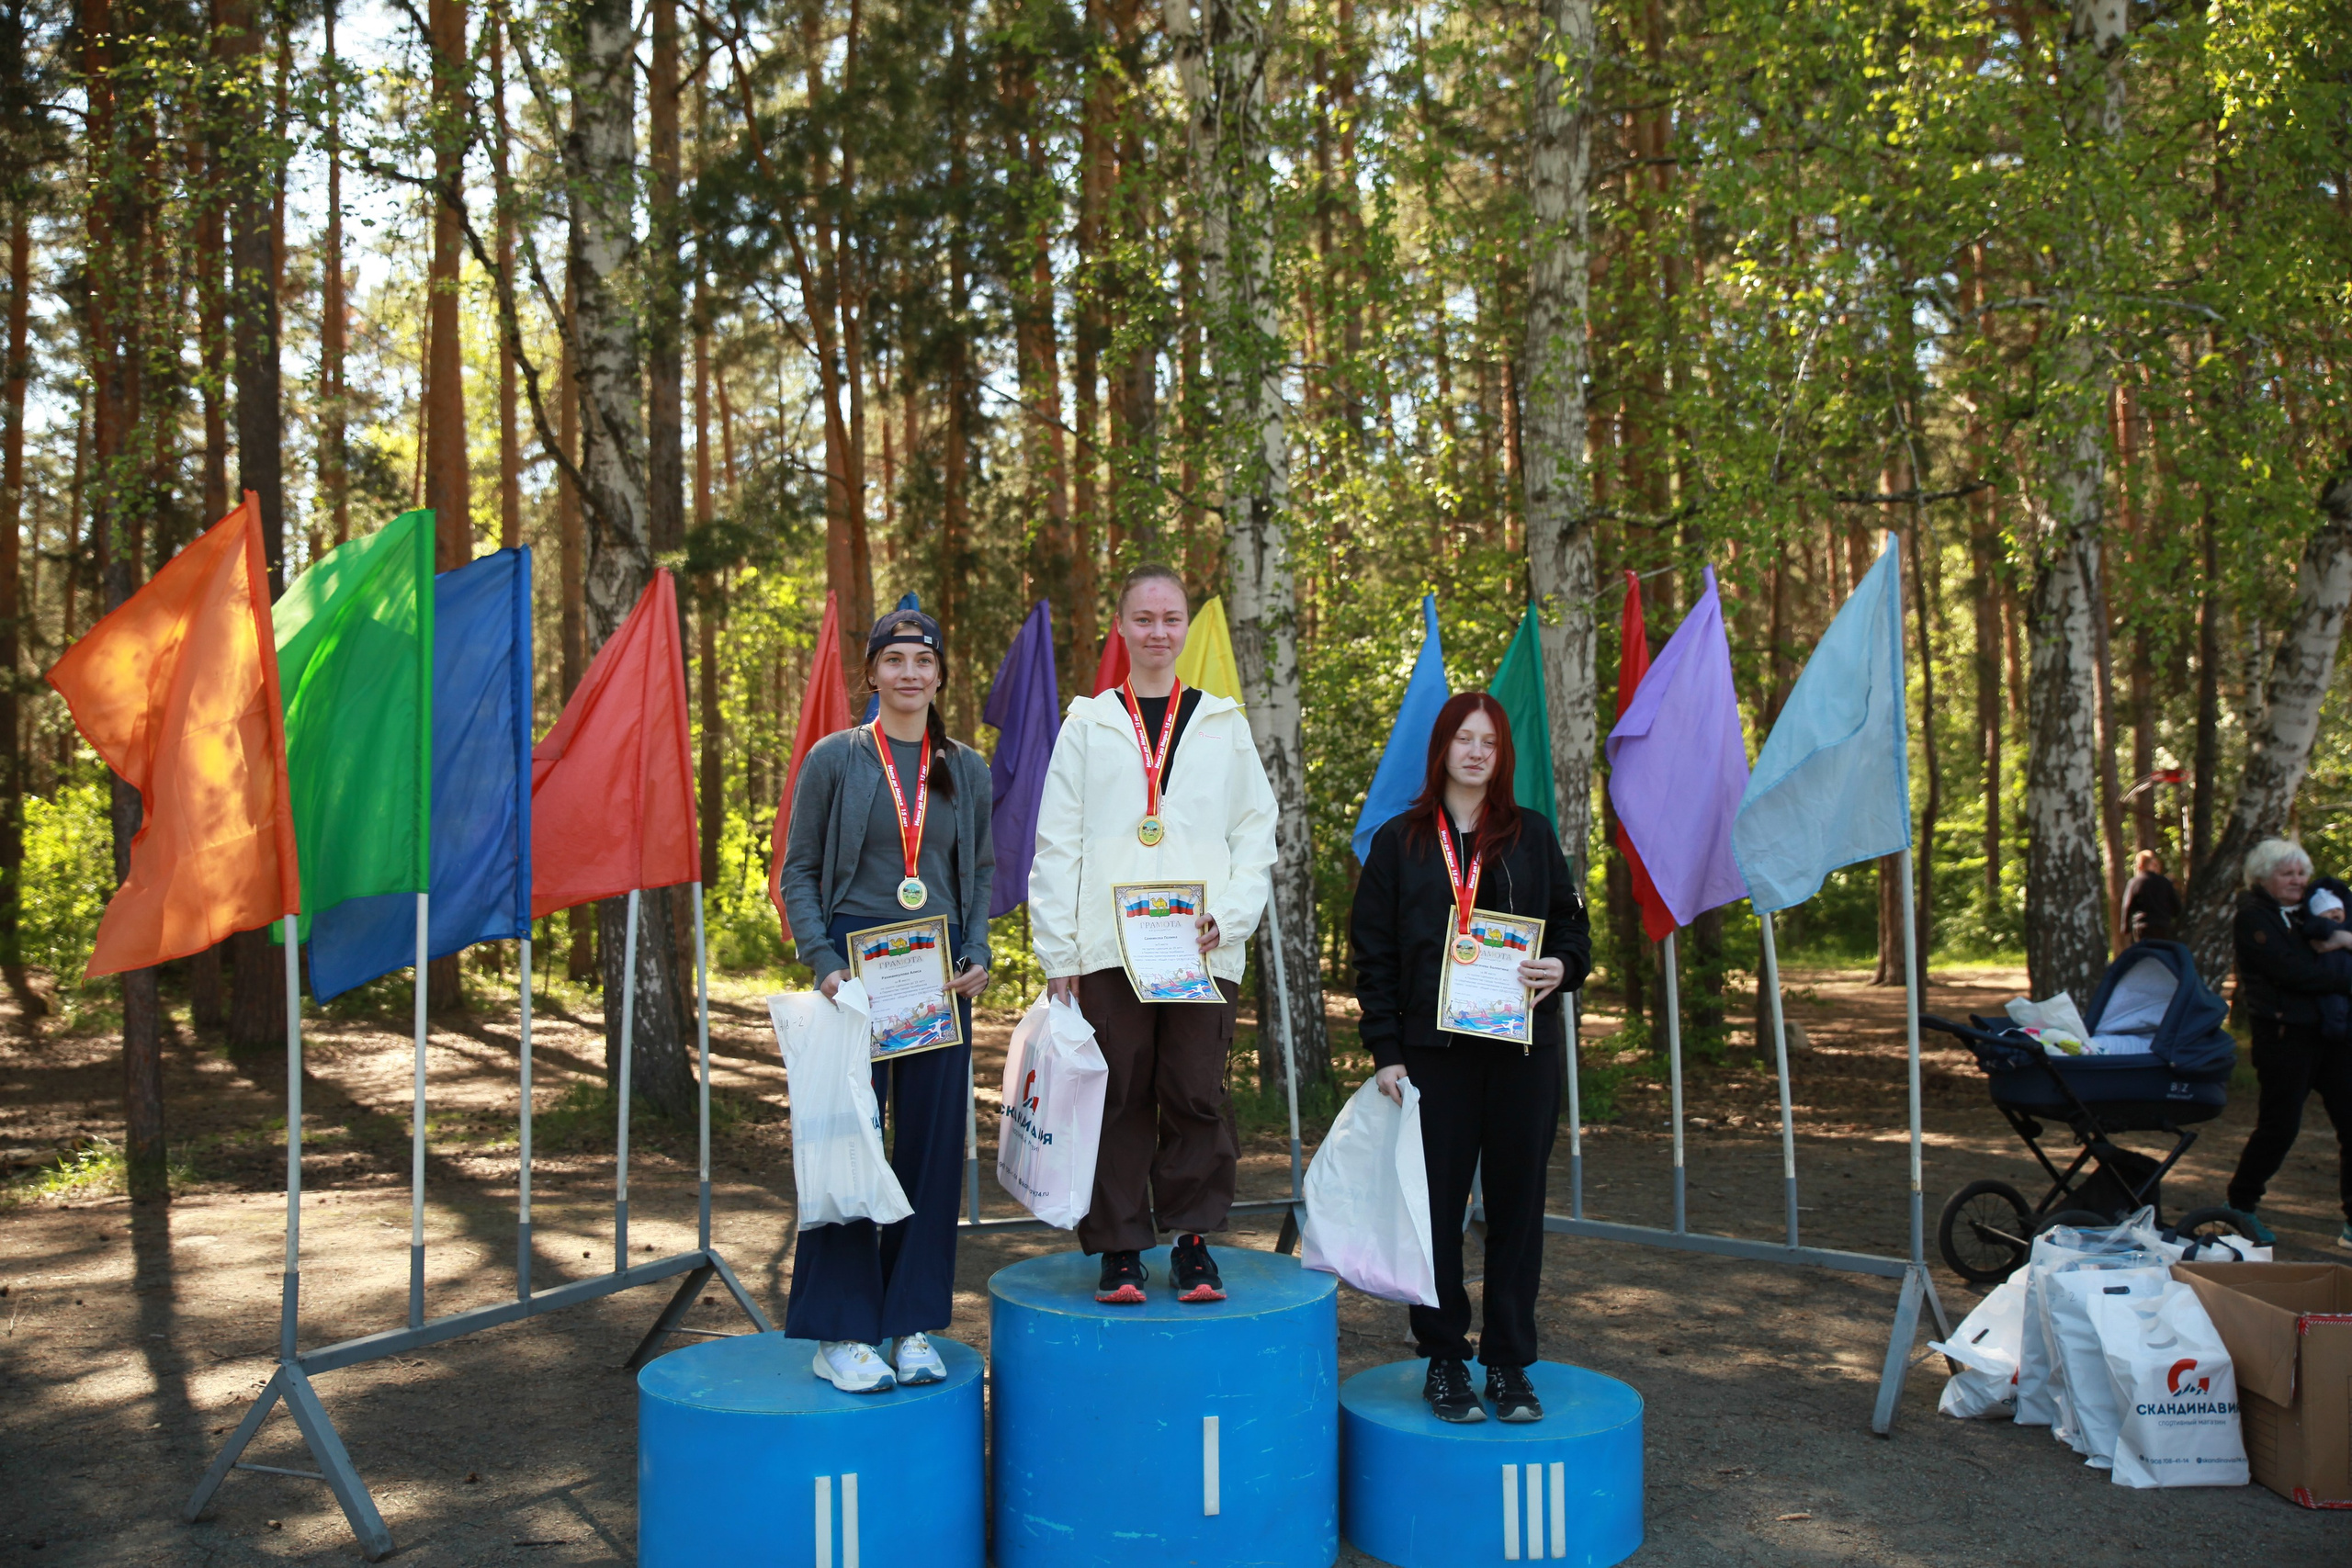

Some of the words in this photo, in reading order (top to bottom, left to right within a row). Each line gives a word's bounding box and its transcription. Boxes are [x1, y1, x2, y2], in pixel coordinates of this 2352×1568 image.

[1160, 731, 1169, 747] Марья
[895, 788, 903, 806] Марья
[1140, 921, 1181, 929] ГРАМОТА
[879, 956, 923, 969] ГРАМОТА
[2158, 1418, 2197, 1427] спортивный
[1501, 1461, 1566, 1561] III
[814, 1472, 860, 1568] II
